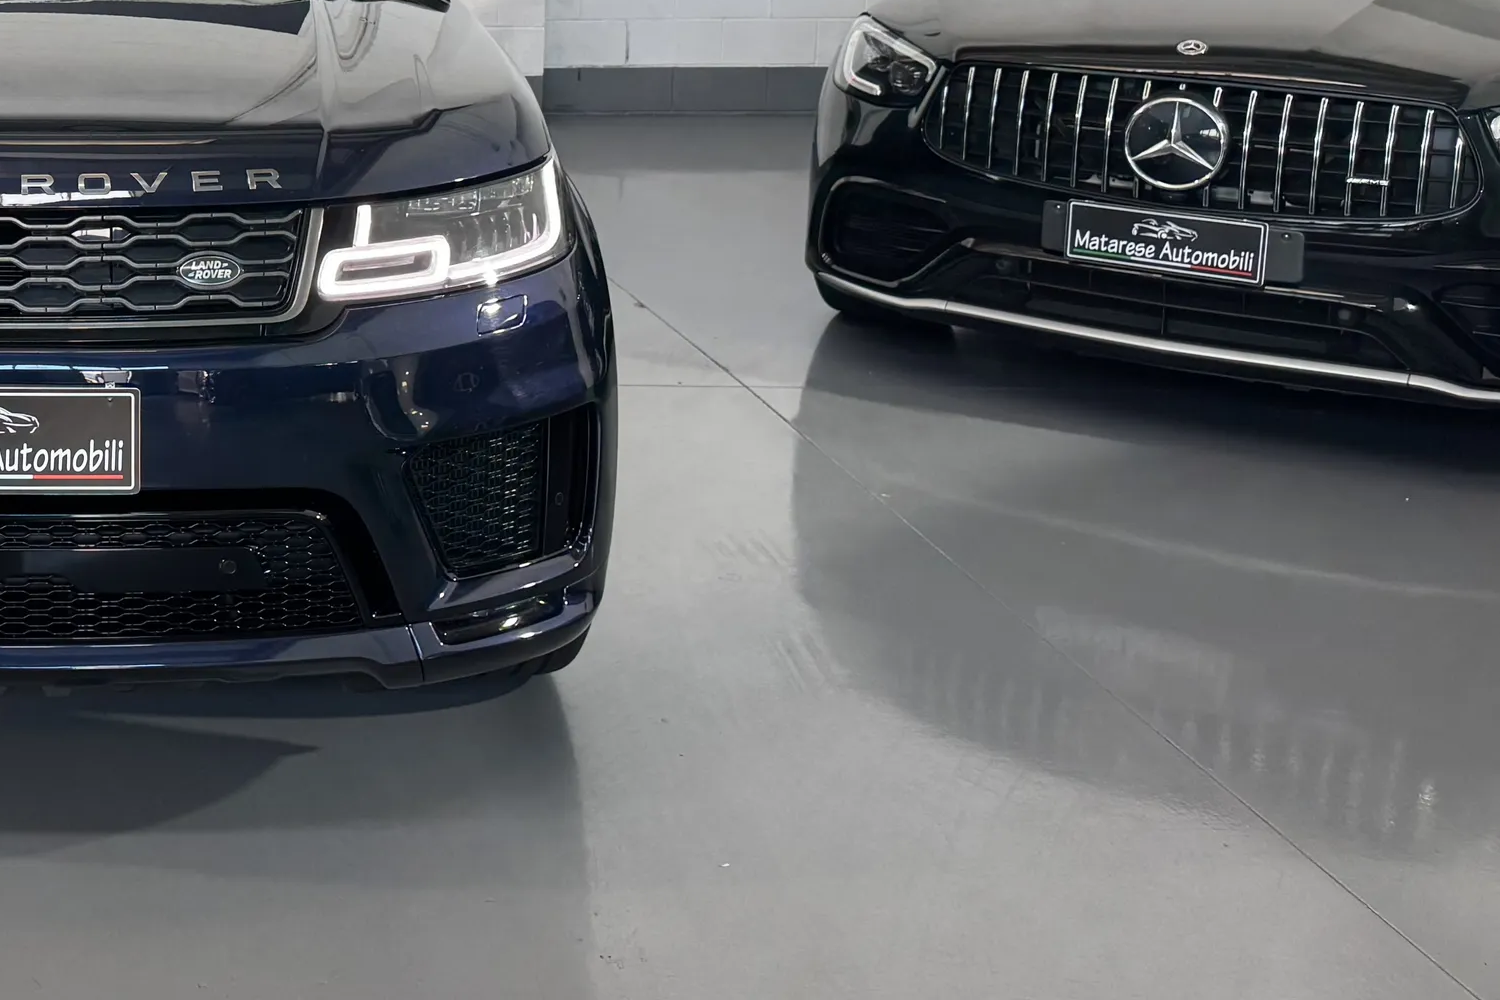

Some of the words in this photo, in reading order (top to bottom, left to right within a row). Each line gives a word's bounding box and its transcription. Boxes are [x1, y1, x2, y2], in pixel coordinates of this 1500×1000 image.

[20, 169, 282, 196] ROVER
[1074, 229, 1155, 258] Matarese
[1159, 241, 1254, 272] Automobili
[190, 260, 221, 270] LAND
[194, 269, 232, 280] ROVER
